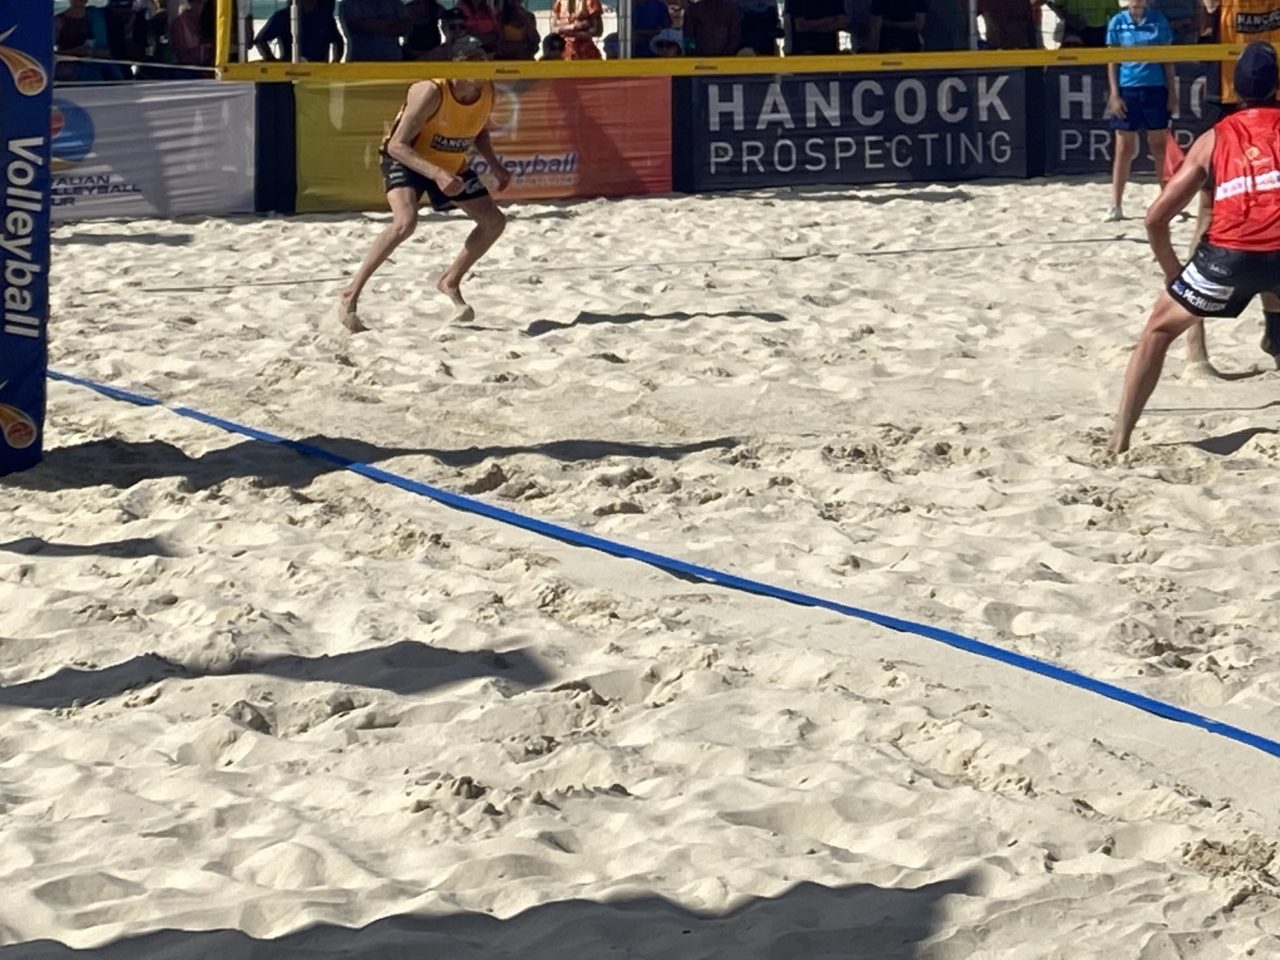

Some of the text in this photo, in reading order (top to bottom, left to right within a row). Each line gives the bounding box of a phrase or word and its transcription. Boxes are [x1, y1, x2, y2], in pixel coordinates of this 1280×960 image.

[708, 75, 1011, 131] HANCOCK
[709, 130, 1012, 175] PROSPECTING
[0, 136, 44, 338] Volleyball
